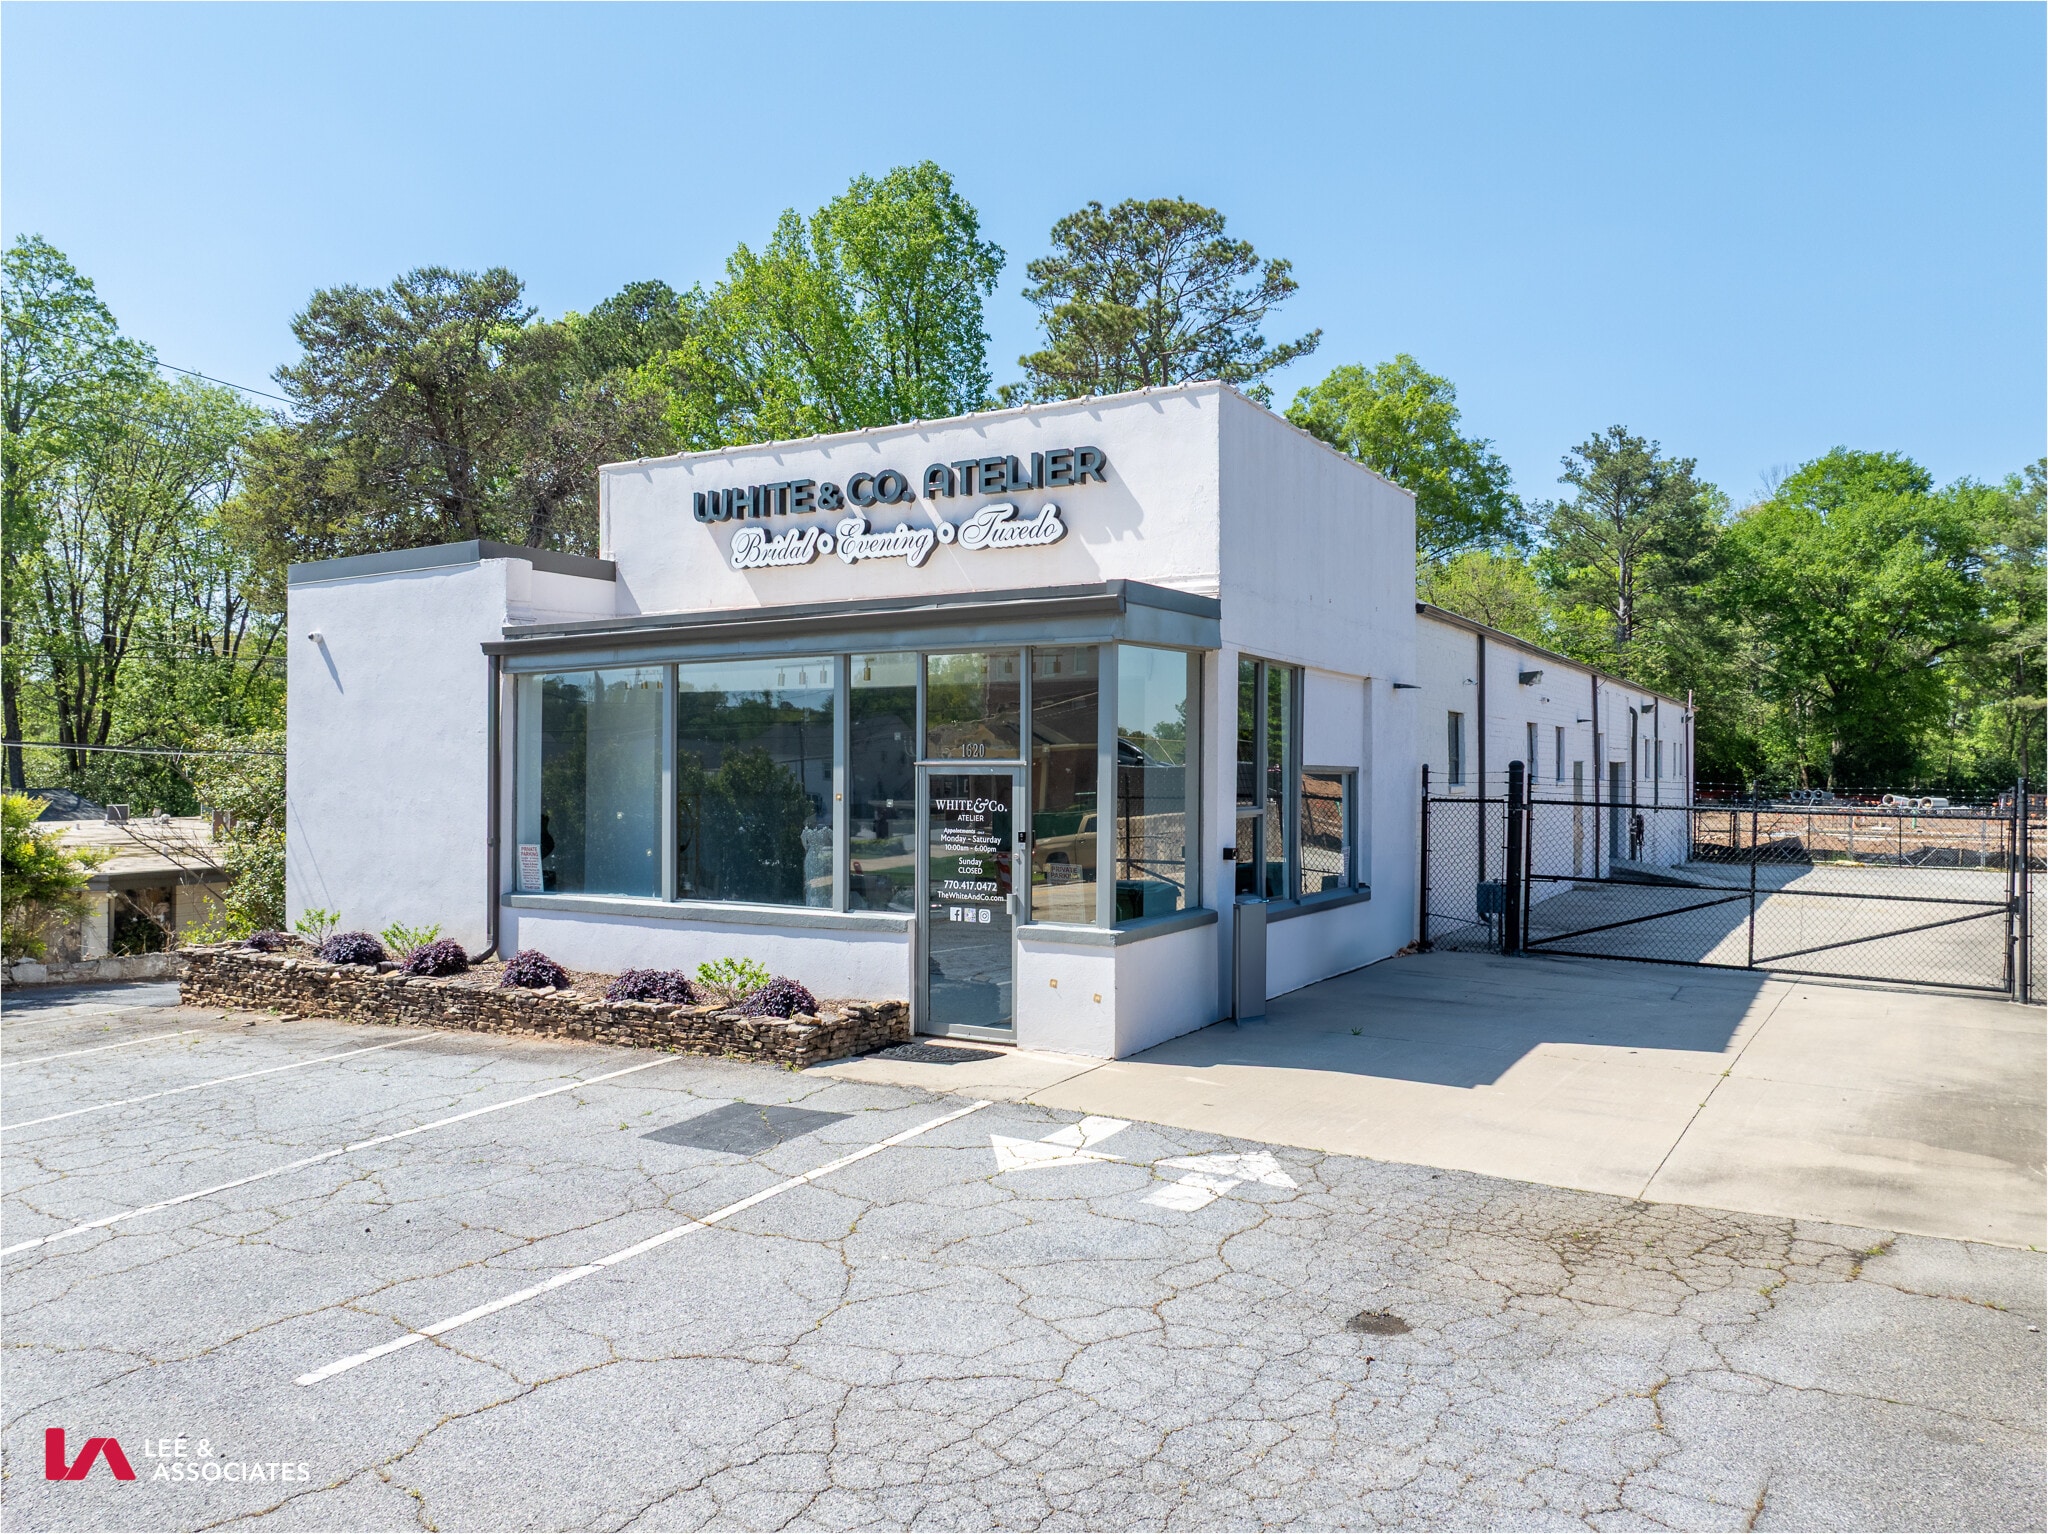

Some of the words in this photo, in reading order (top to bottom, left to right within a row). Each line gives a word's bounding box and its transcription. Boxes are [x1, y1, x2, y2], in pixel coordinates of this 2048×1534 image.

[693, 479, 816, 523] WHITE
[817, 481, 844, 511] &
[847, 468, 916, 508] CO.
[923, 446, 1106, 500] ATELIER
[733, 530, 814, 565] Bridal
[839, 522, 930, 562] Evening
[961, 508, 1059, 545] Tuxedo
[961, 743, 985, 758] 1620
[957, 814, 985, 822] ATELIER
[940, 834, 967, 844] Monday
[972, 834, 1002, 845] Saturday
[945, 843, 969, 851] 10:00am
[974, 845, 997, 853] 6:00pm
[958, 857, 982, 867] Sunday
[958, 866, 983, 875] CLOSED
[1051, 866, 1078, 874] PRIVATE
[944, 880, 997, 892] 770.417.0472
[937, 890, 1004, 902] TheWhiteAndCo.com
